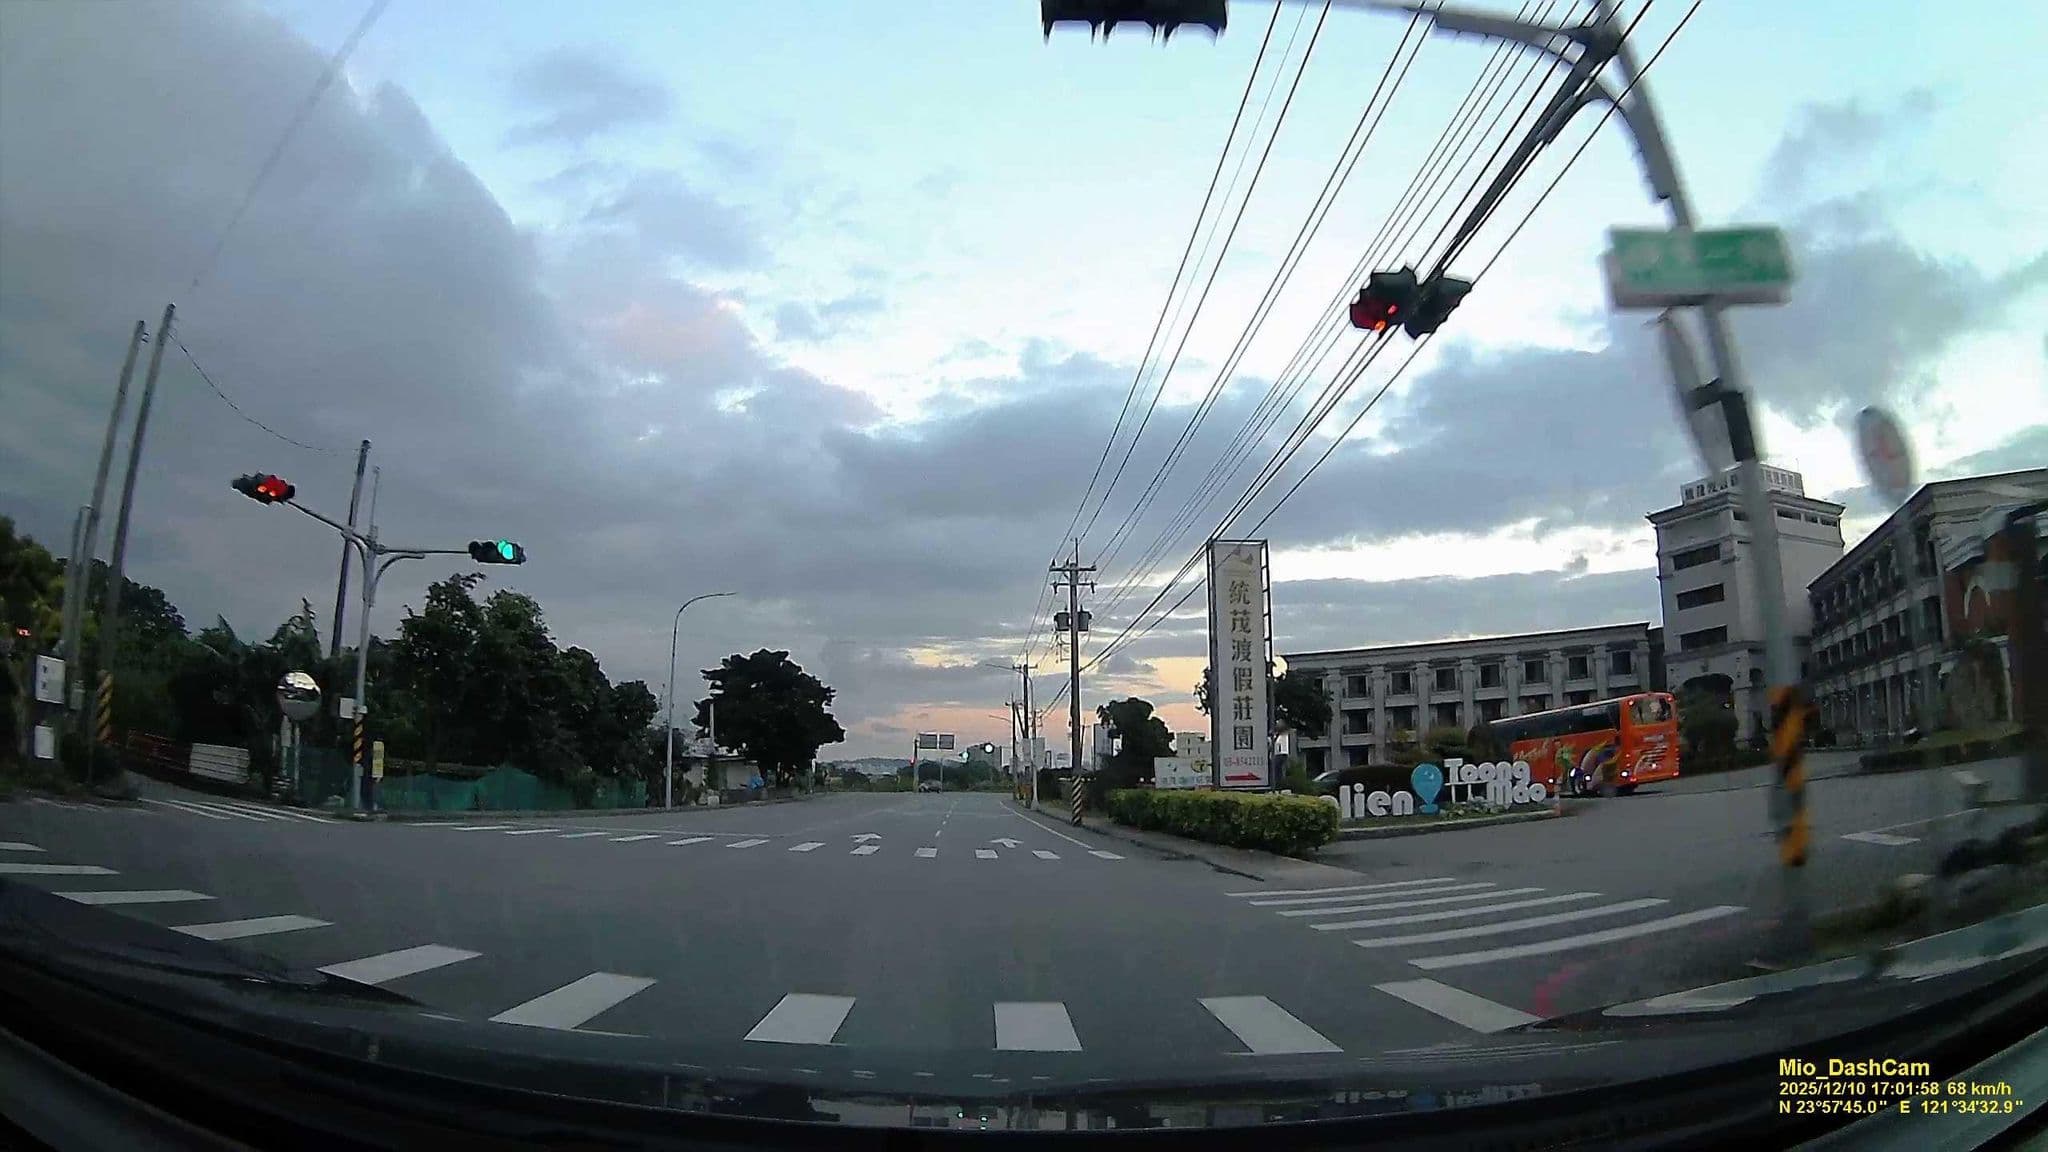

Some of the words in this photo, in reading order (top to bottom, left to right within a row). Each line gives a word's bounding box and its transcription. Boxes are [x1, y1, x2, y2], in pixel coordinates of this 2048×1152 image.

[1228, 580, 1254, 751] 統茂渡假莊園
[1443, 758, 1532, 785] Toong
